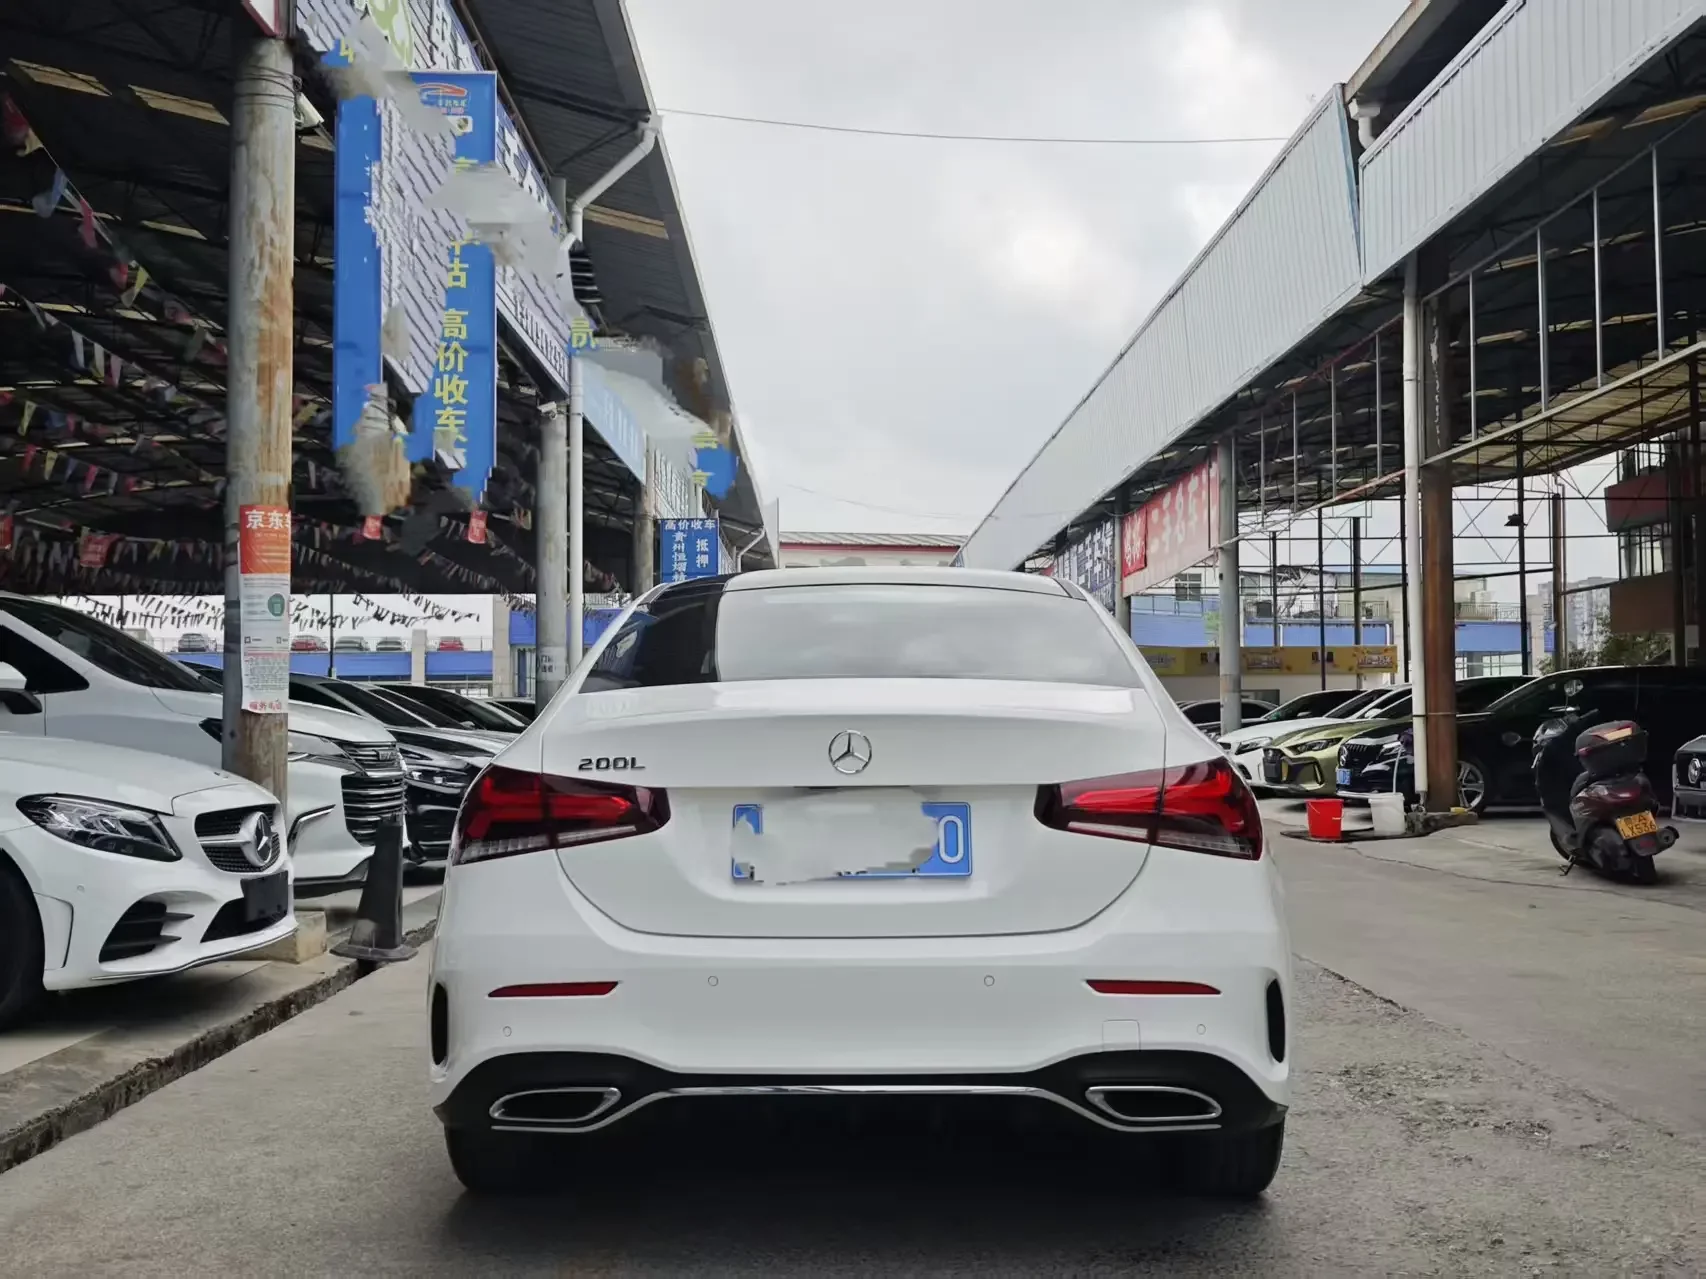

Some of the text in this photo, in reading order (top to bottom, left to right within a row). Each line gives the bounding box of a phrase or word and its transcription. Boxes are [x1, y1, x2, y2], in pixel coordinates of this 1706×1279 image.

[665, 519, 716, 531] 高价收车
[578, 757, 646, 771] 200L
